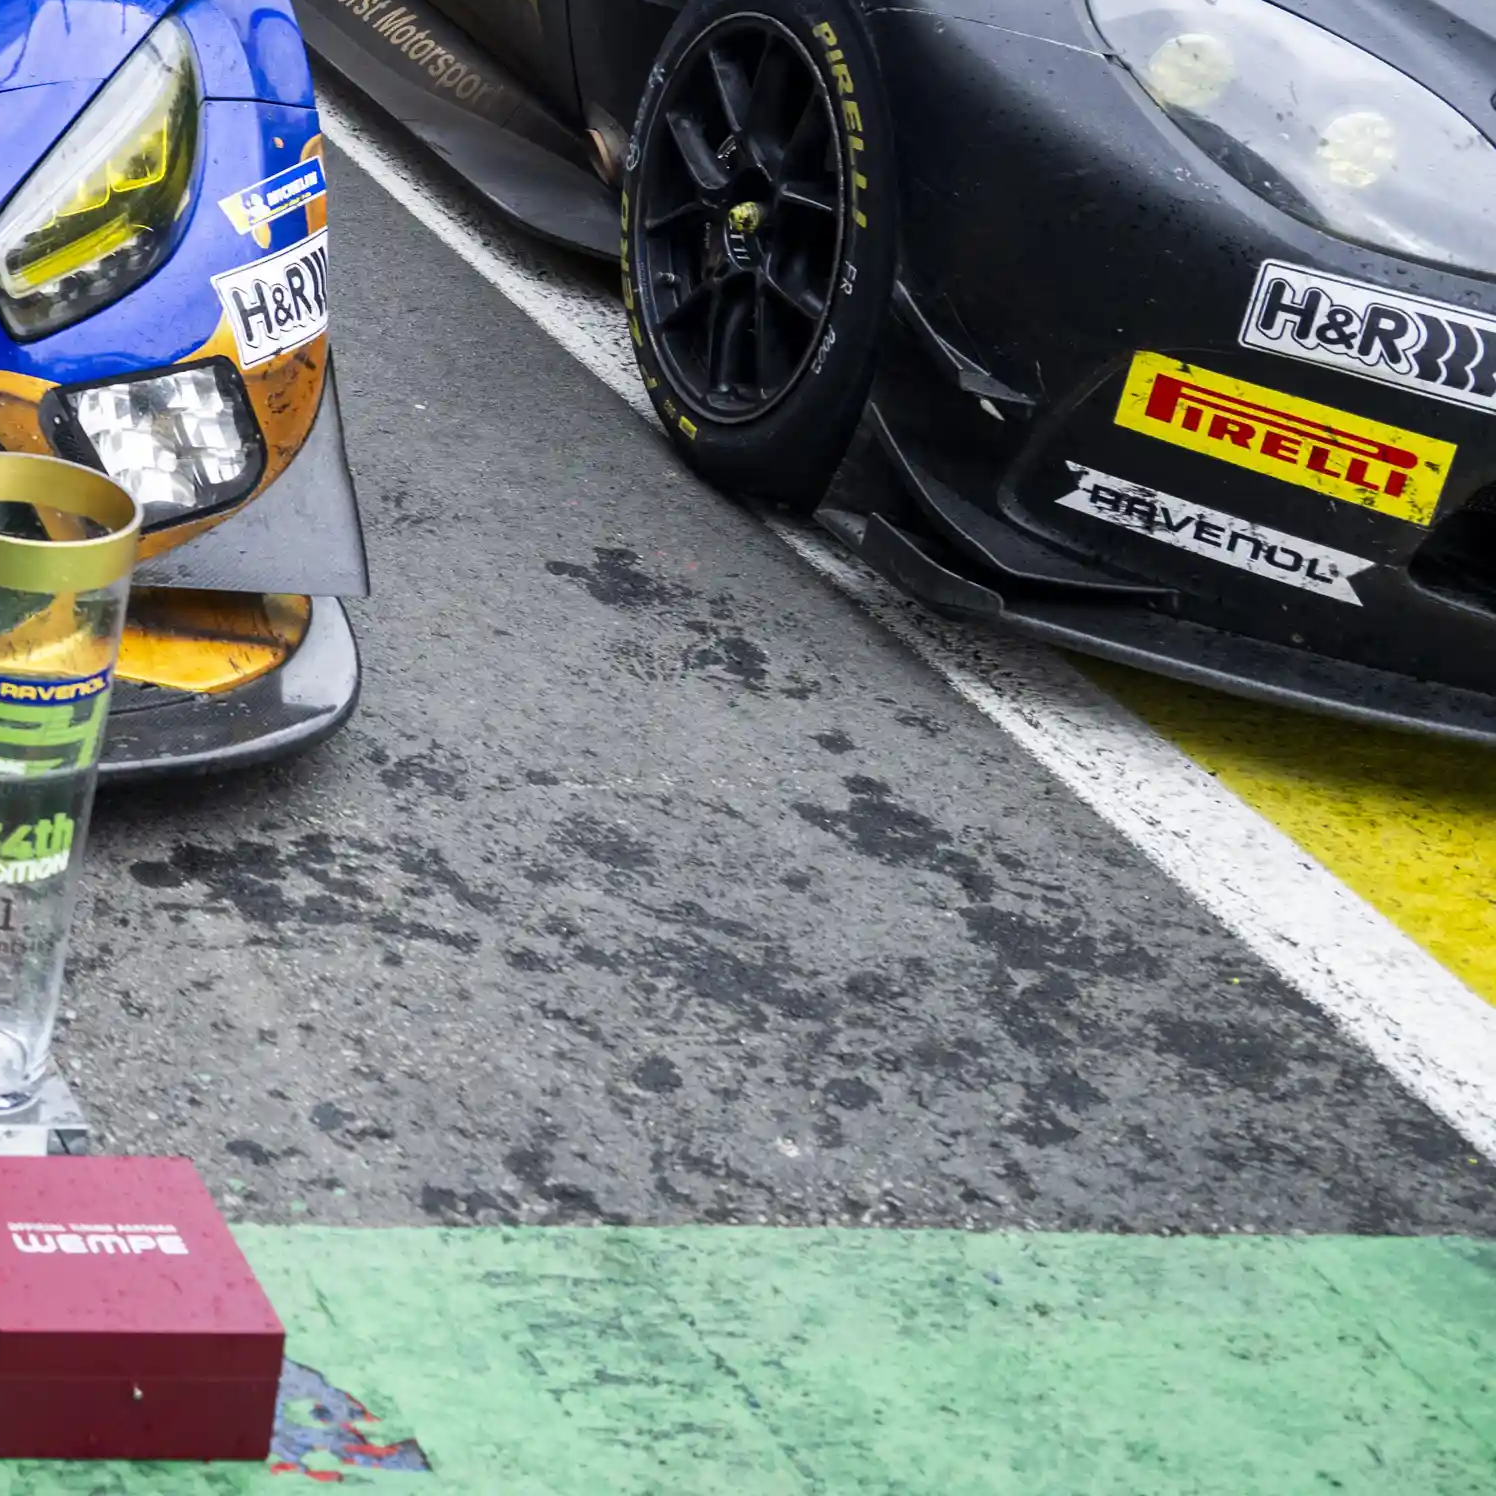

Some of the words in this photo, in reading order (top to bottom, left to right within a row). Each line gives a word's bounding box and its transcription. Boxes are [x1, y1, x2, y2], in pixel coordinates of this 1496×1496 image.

[374, 8, 500, 106] Motorspor
[811, 20, 869, 230] PIRELLI
[231, 265, 312, 342] H&R
[1259, 280, 1412, 366] H&R
[1144, 371, 1420, 500] PIRELLI
[1088, 483, 1339, 585] RAVENOL
[0, 673, 106, 701] RAVENOL
[11, 1233, 189, 1256] WEMPE
